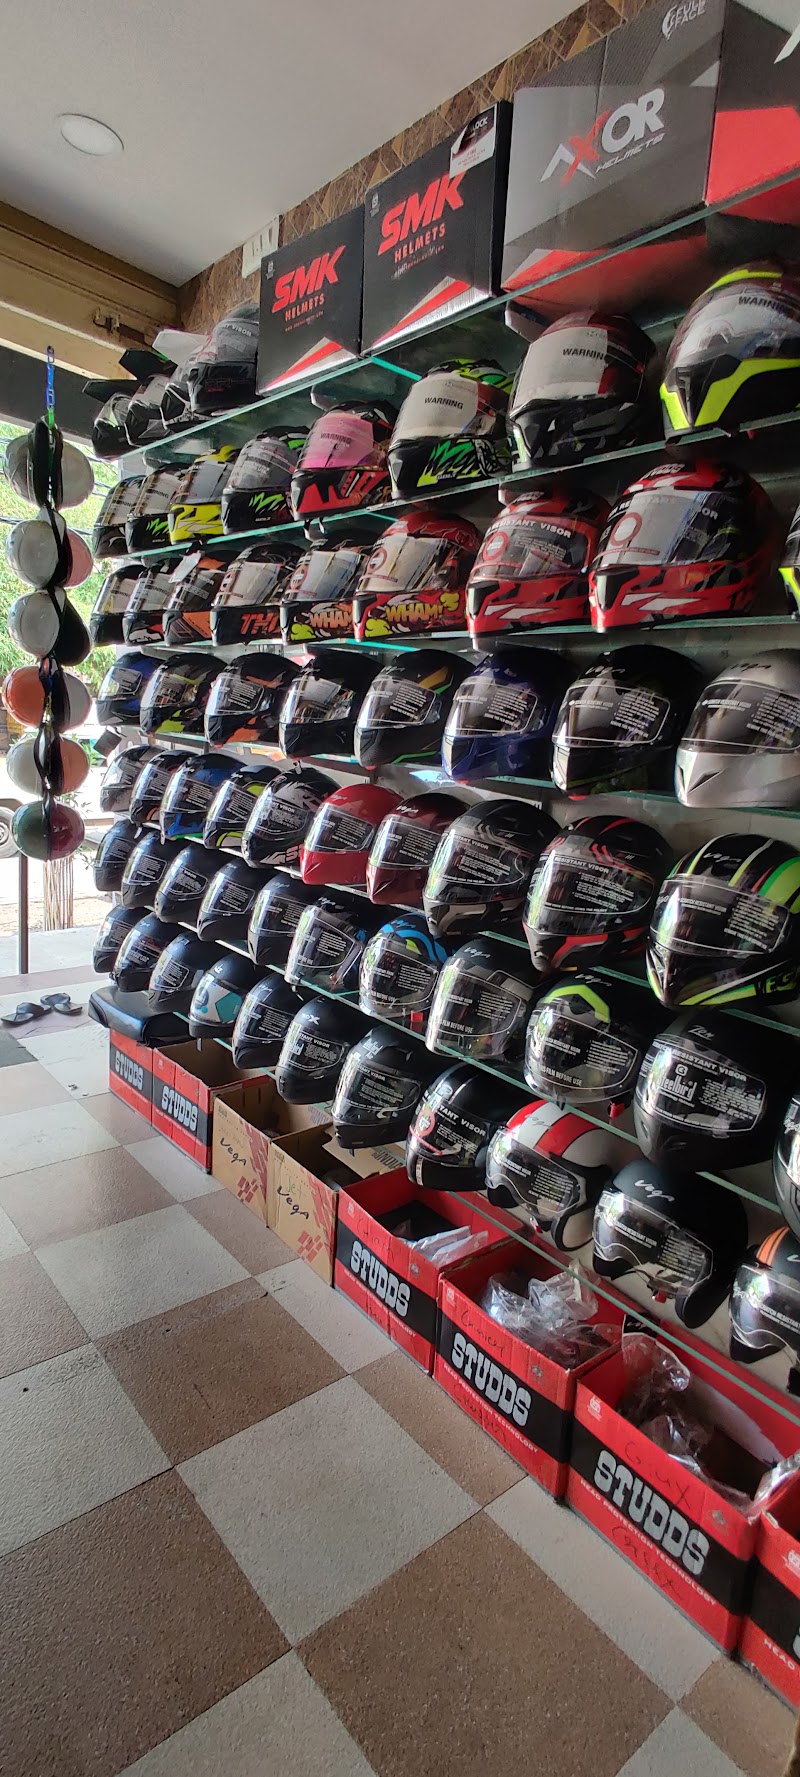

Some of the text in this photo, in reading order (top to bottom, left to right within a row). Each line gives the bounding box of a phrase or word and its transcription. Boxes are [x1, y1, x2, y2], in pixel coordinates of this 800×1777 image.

[674, 6, 706, 28] FACE
[540, 88, 665, 188] AXOR
[595, 132, 665, 174] HELMETS
[378, 170, 467, 256] SMK
[394, 222, 446, 264] HELMETS
[271, 244, 347, 314] SMK
[284, 292, 325, 322] HELMETS
[562, 347, 604, 361] WARNIN
[425, 397, 463, 410] WARNING
[320, 433, 351, 446] WARNING
[540, 522, 572, 538] VISOR
[471, 840, 489, 850] VISOR
[554, 855, 610, 874] RESISTANT VISOR
[313, 1037, 331, 1049] VISOR
[451, 1022, 465, 1032] BEFORE
[114, 1050, 144, 1091] STUDDS
[555, 1071, 573, 1083] BEFORE
[572, 1077, 583, 1087] USE
[672, 1049, 718, 1070] RESISTANT
[719, 1066, 747, 1081] VISOR
[161, 1085, 198, 1132] STUDDS
[461, 1118, 486, 1137] VISOR
[634, 1179, 676, 1203] Vega
[350, 1240, 411, 1318] STUDDS
[451, 1332, 532, 1427] STUDDS
[443, 1363, 458, 1381] HEAD
[458, 1379, 493, 1415] PROTECTION
[494, 1413, 539, 1453] TECHNOLOGY
[593, 1449, 710, 1576] STUDDS
[579, 1478, 601, 1501] HEAD
[602, 1499, 654, 1550] PROTECTION
[654, 1549, 717, 1606] TECHNOLOGY
[763, 1638, 796, 1671] HEAD
